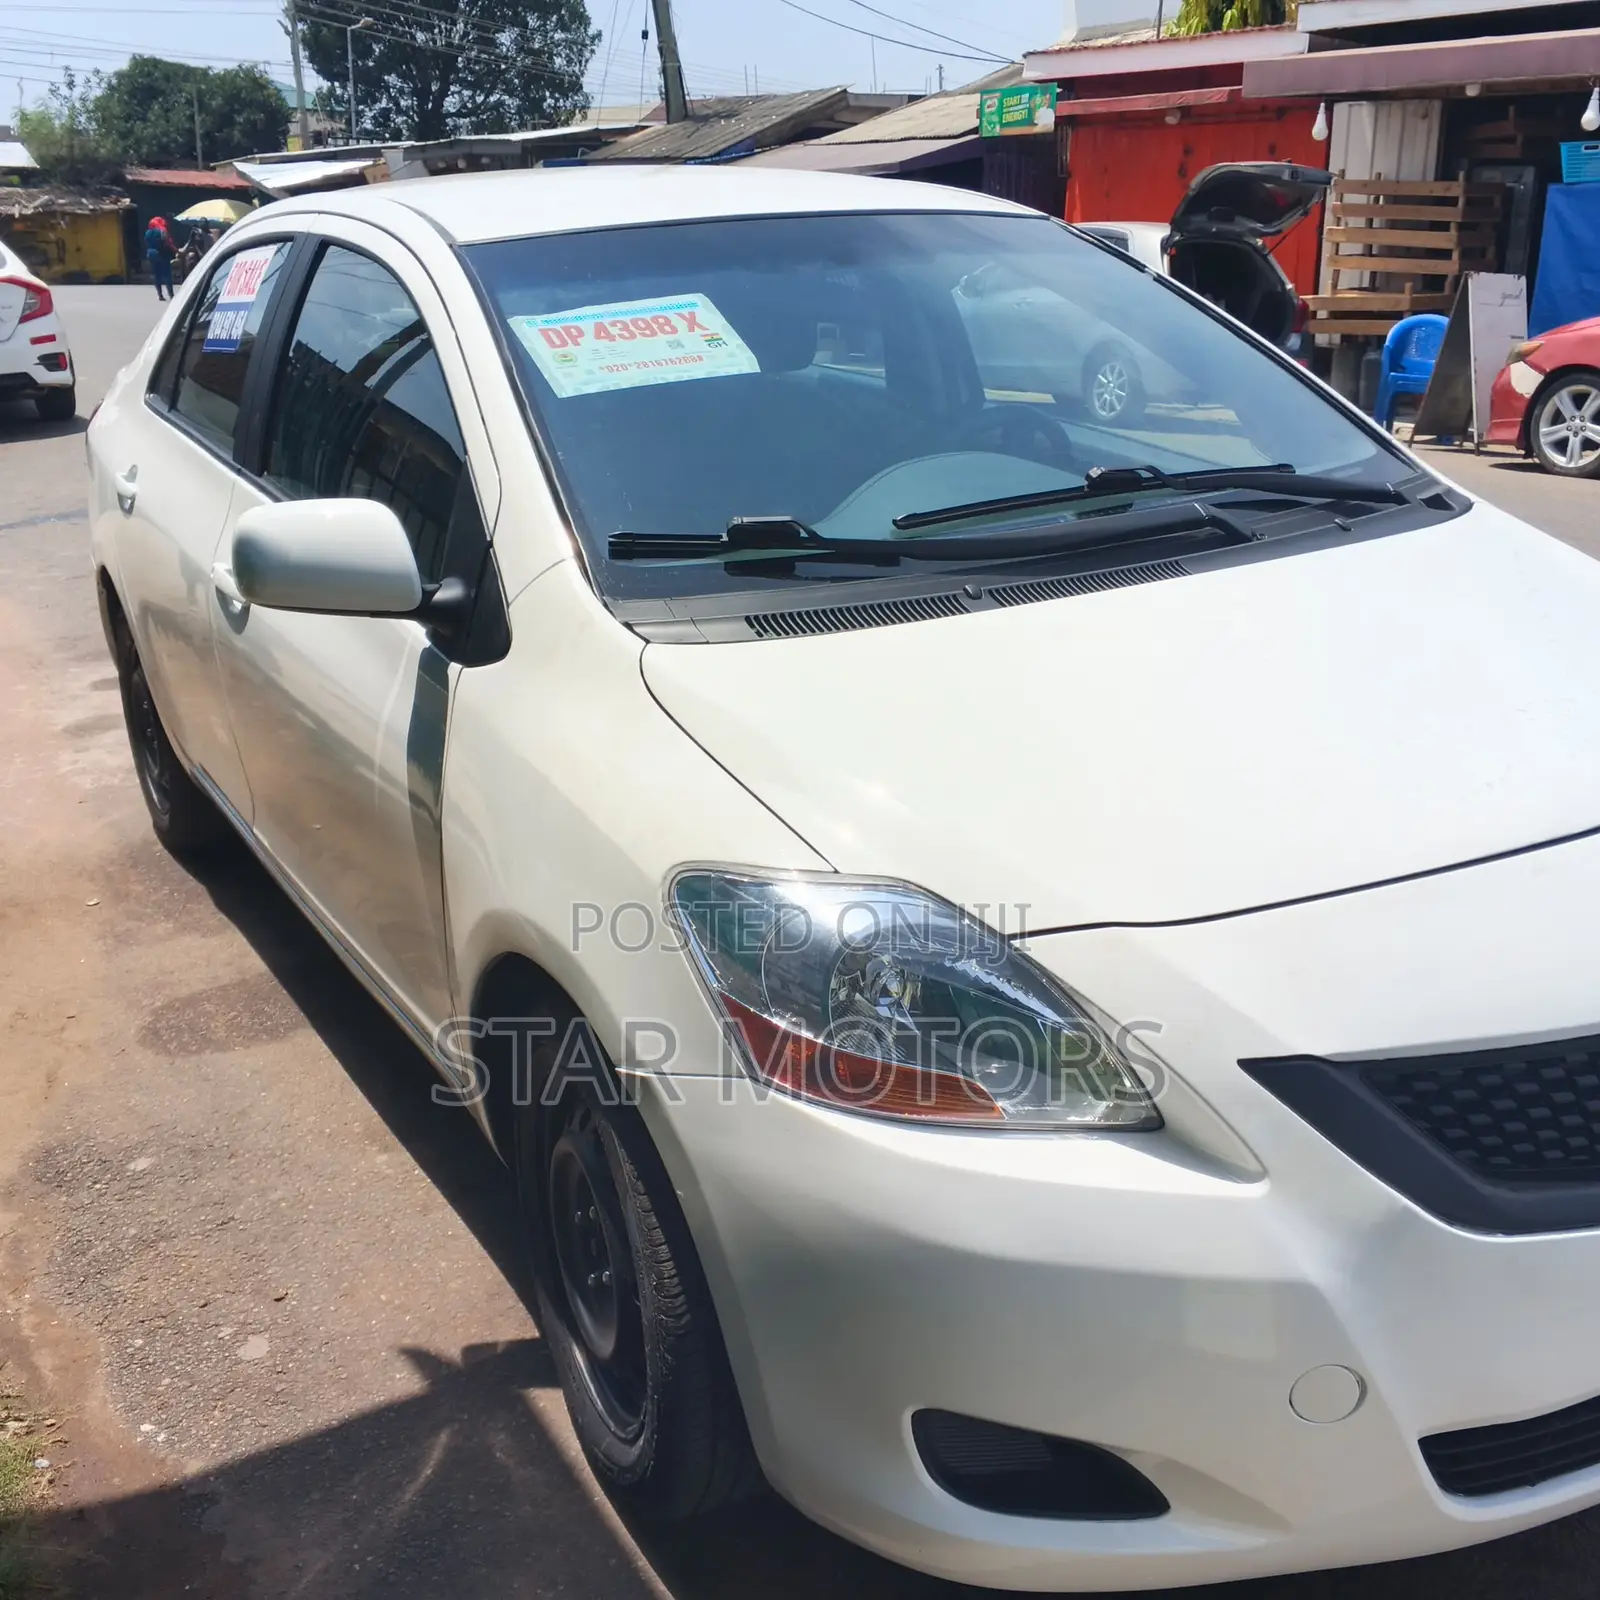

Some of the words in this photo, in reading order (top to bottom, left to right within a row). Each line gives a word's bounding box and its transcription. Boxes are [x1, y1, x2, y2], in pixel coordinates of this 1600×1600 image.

[537, 325, 585, 349] DP
[593, 314, 678, 343] 4398
[674, 311, 709, 333] X
[707, 340, 729, 350] GH
